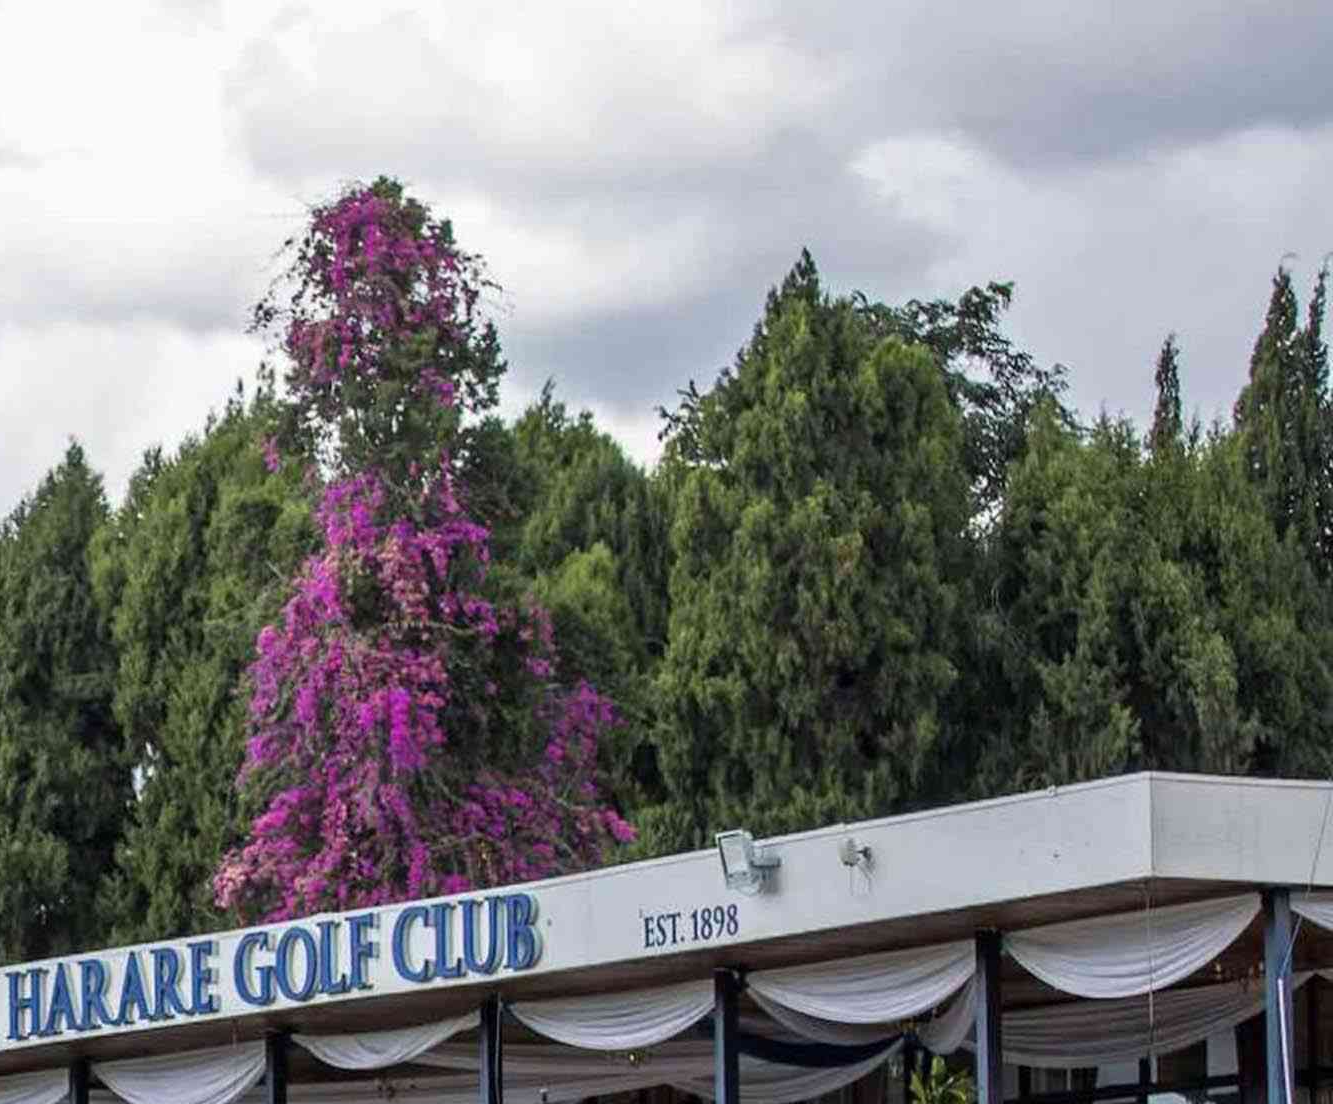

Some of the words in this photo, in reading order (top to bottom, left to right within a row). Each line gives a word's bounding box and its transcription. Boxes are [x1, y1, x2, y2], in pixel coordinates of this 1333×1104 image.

[5, 940, 220, 1041] HARARE
[233, 912, 380, 1006] GOLF
[392, 893, 543, 983] CLUB
[644, 912, 685, 948] EST.
[691, 903, 739, 941] 1898
